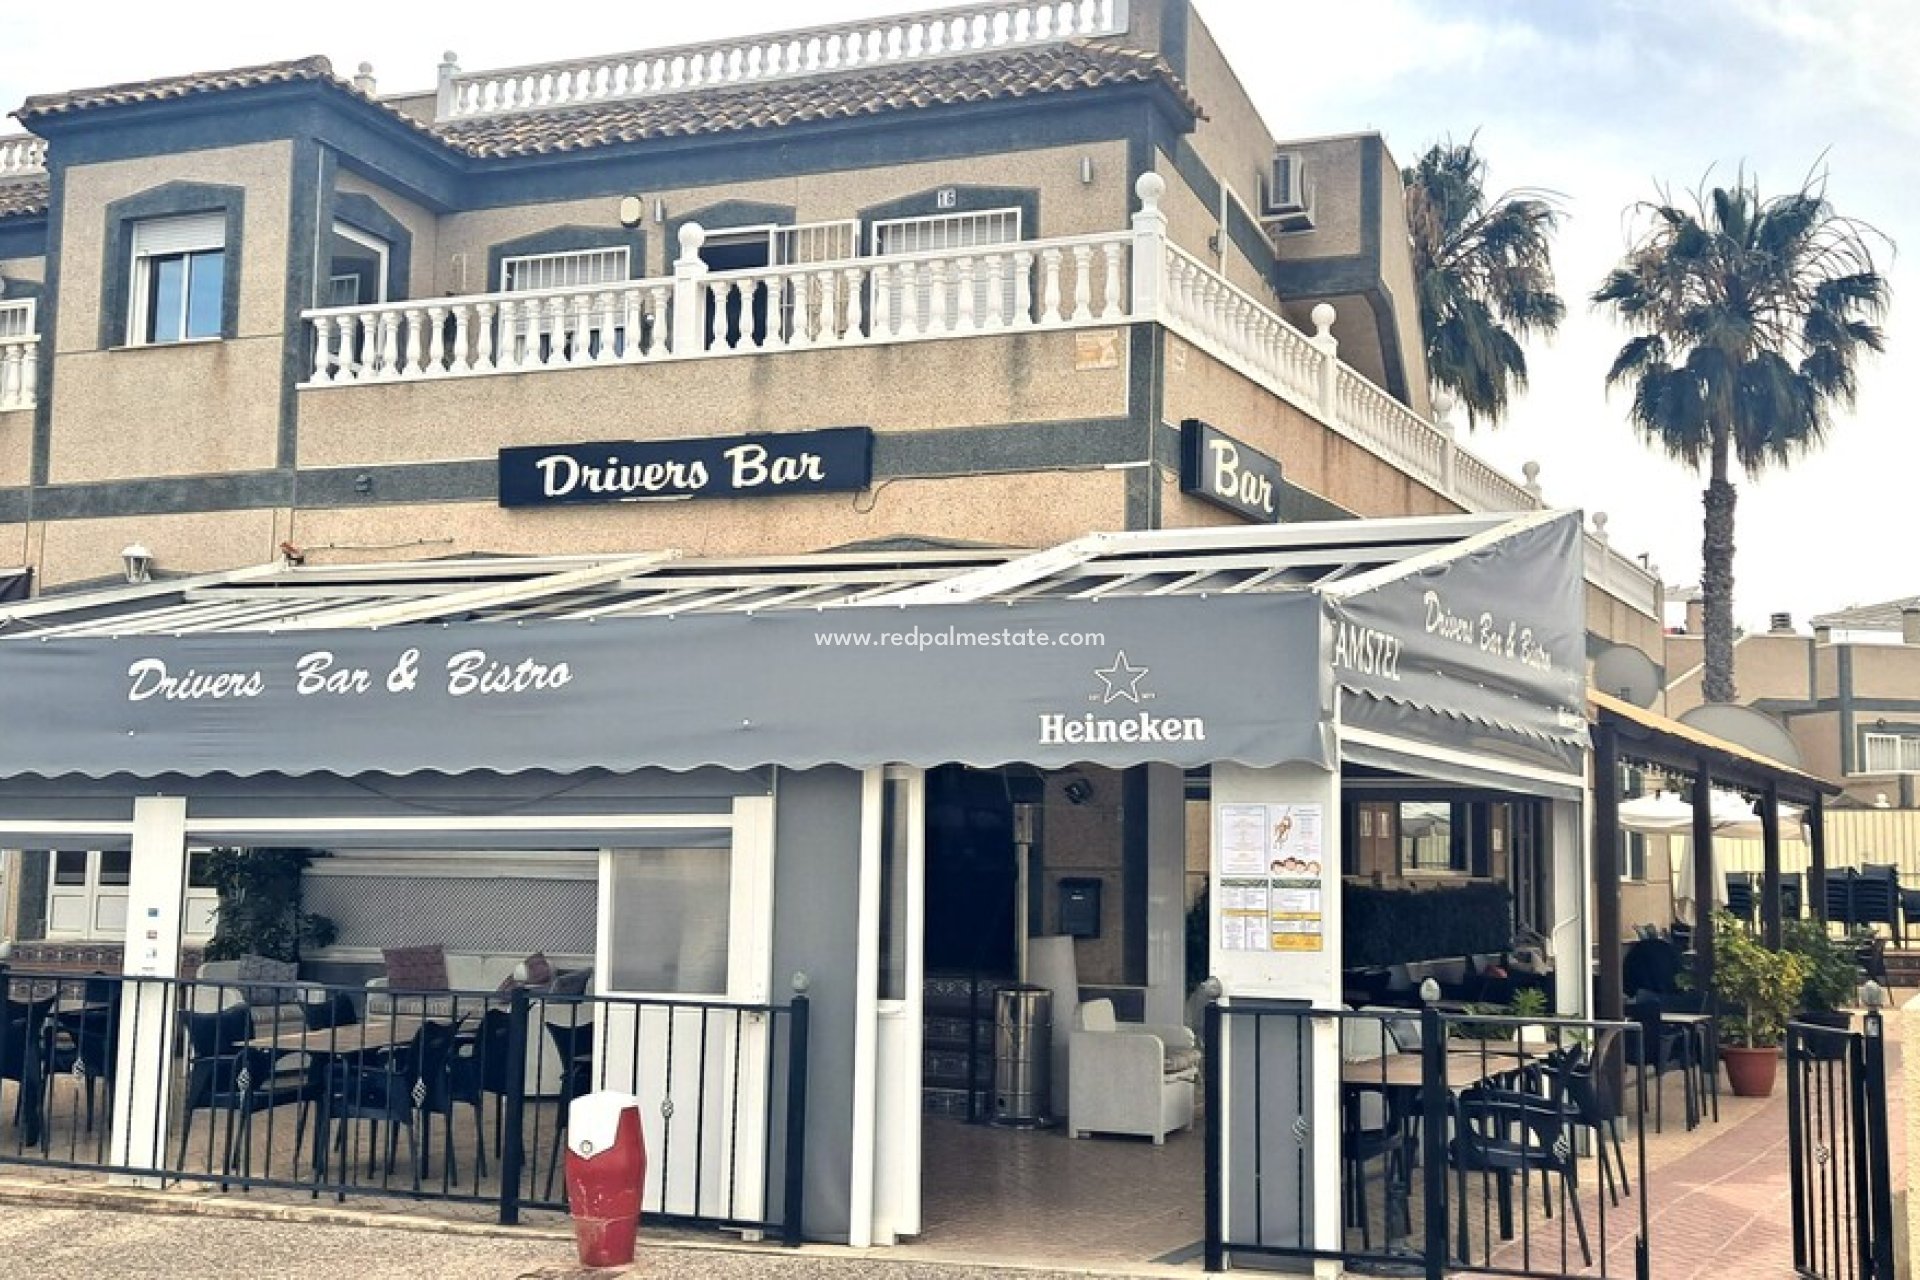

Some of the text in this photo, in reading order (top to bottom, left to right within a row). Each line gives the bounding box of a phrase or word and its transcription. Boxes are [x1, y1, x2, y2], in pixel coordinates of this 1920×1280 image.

[536, 444, 825, 497] Drivers Bar
[1208, 439, 1274, 513] Bar
[1332, 618, 1401, 681] AMSTEL
[1423, 590, 1473, 644] Drivers
[1479, 611, 1502, 656] Bar
[128, 648, 574, 700] Drivers Bar & Bistro
[1039, 711, 1206, 745] Heineken
